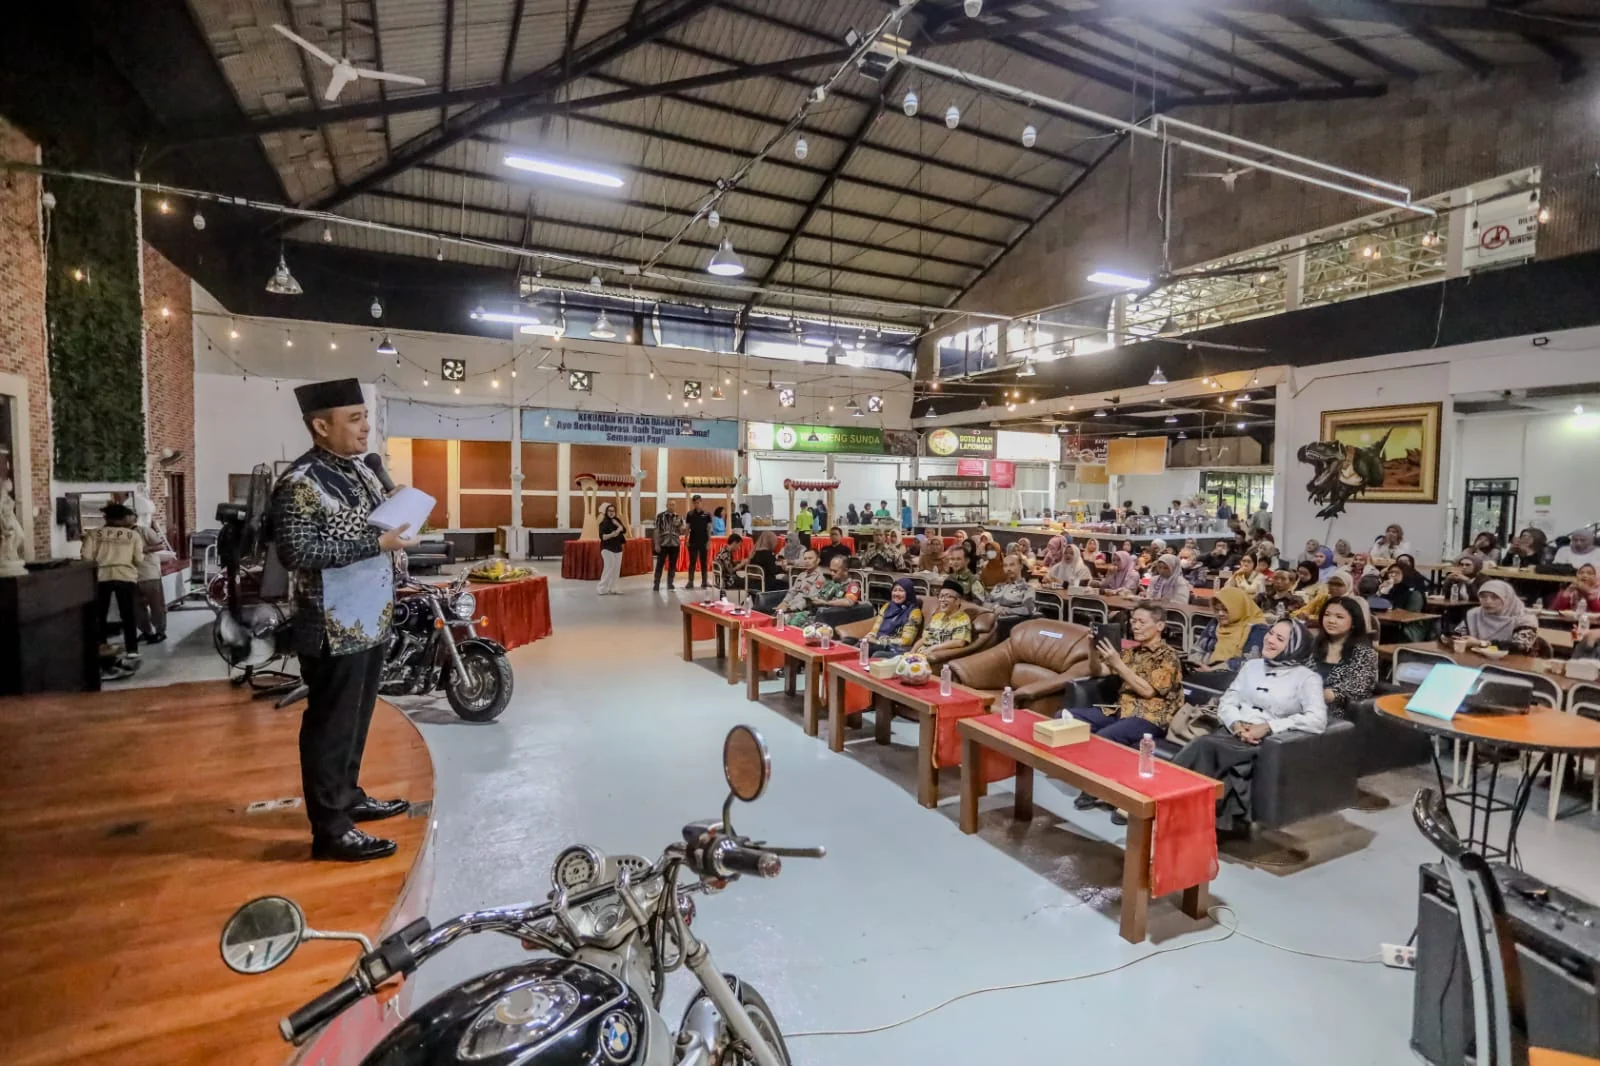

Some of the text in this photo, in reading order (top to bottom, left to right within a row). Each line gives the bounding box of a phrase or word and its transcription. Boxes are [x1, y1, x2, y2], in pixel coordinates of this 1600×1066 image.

[578, 413, 616, 424] KEKUATAN
[617, 415, 634, 424] KITA
[556, 420, 572, 430] Ayo
[651, 426, 675, 436] Target
[606, 432, 646, 443] Semangat
[800, 432, 880, 444] WROENG SUNDA
